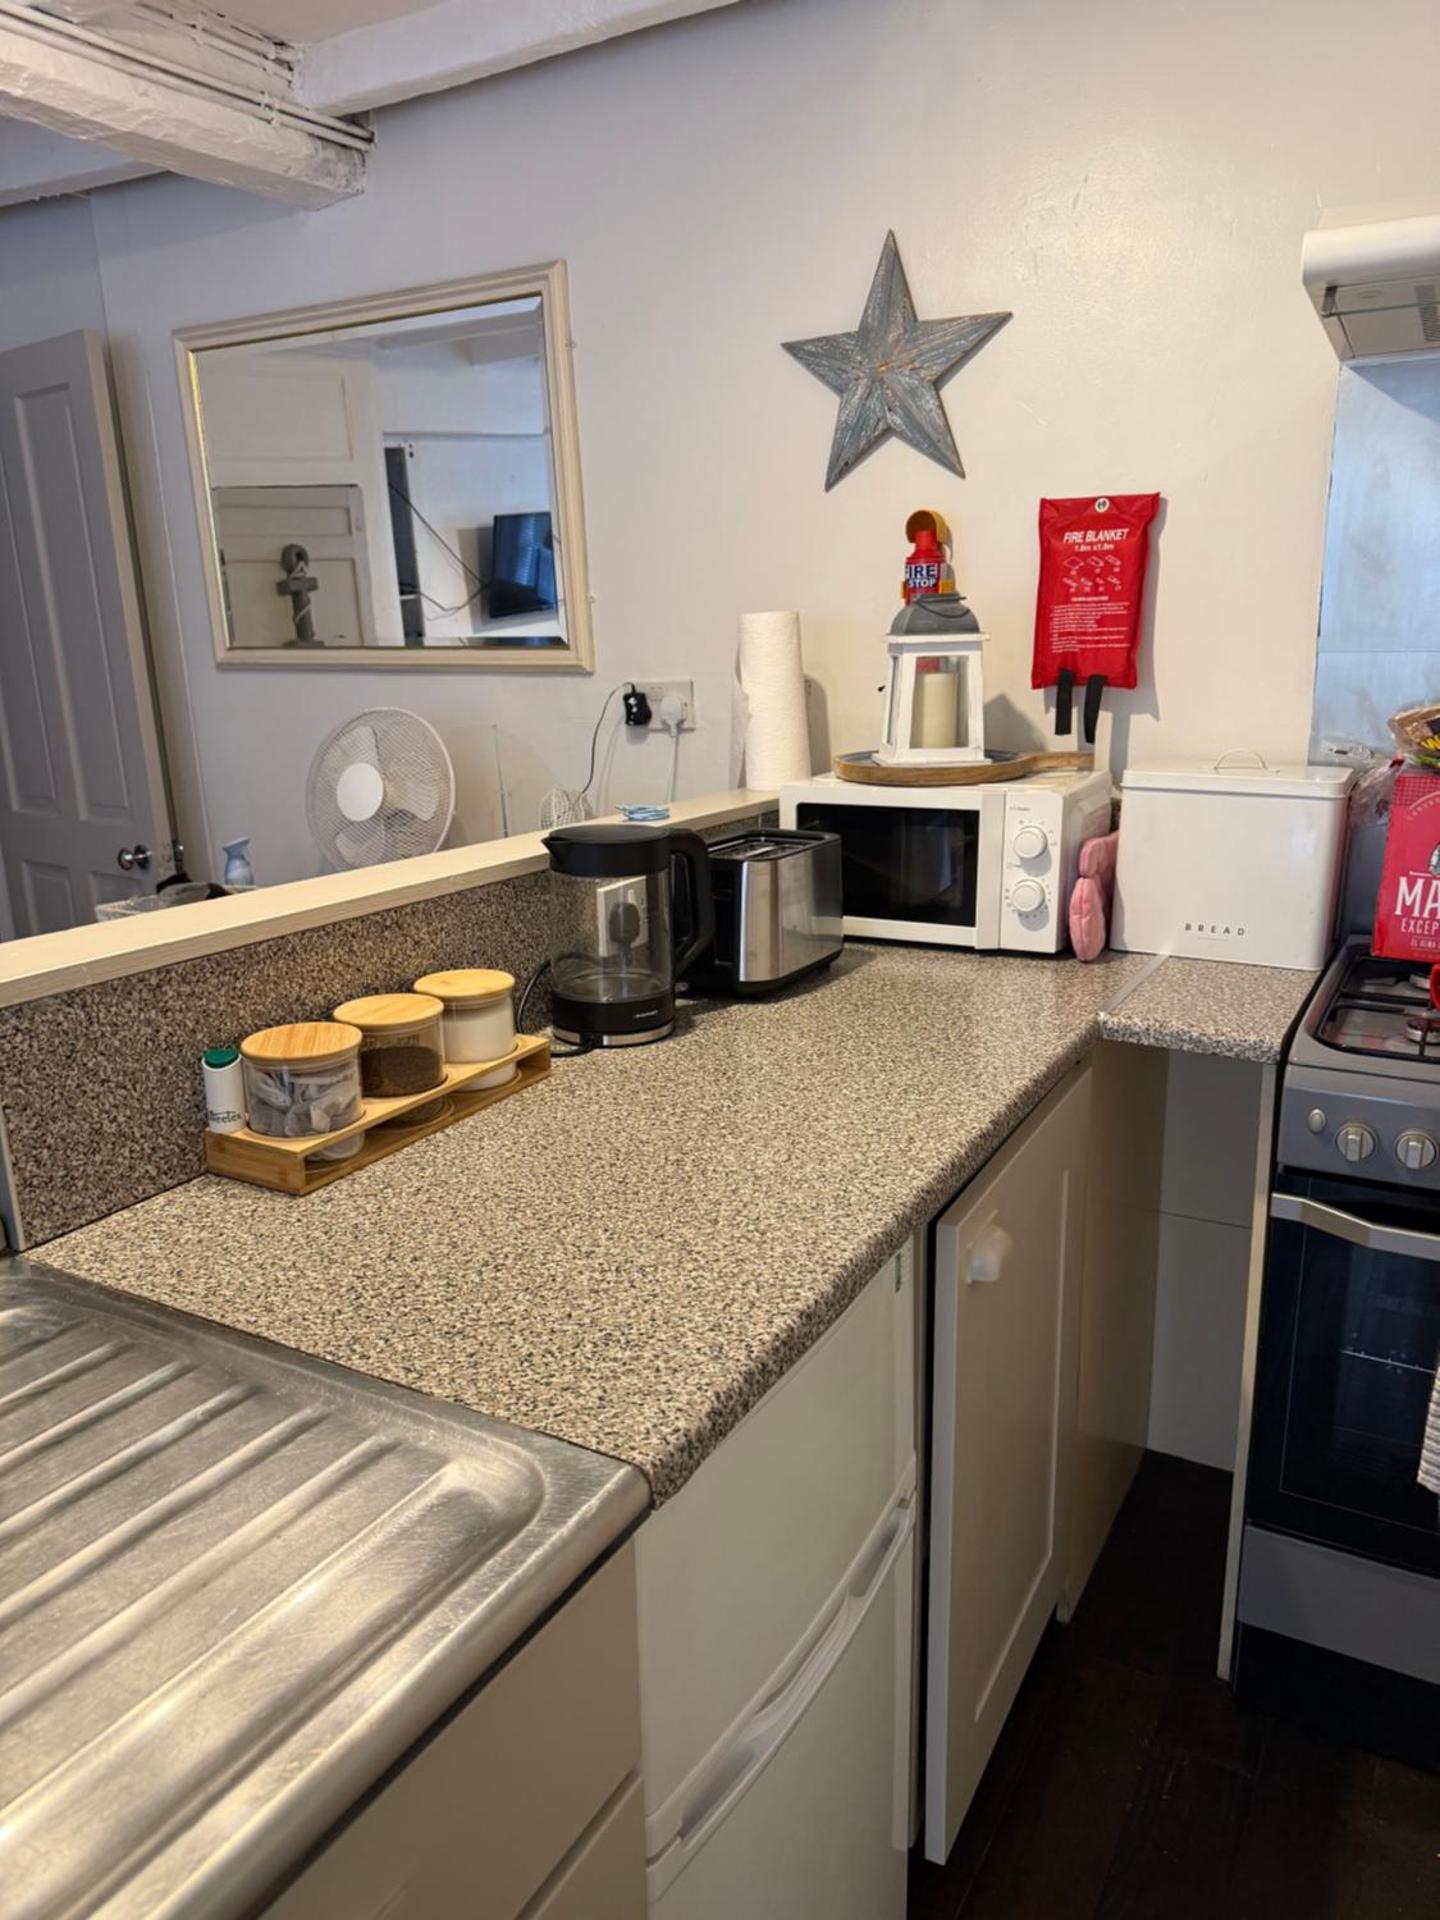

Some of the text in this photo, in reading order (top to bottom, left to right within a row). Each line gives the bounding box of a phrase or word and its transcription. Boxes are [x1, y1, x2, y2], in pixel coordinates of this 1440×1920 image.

[1063, 528, 1130, 544] FIRE BLANKET
[1184, 922, 1245, 937] BREAD
